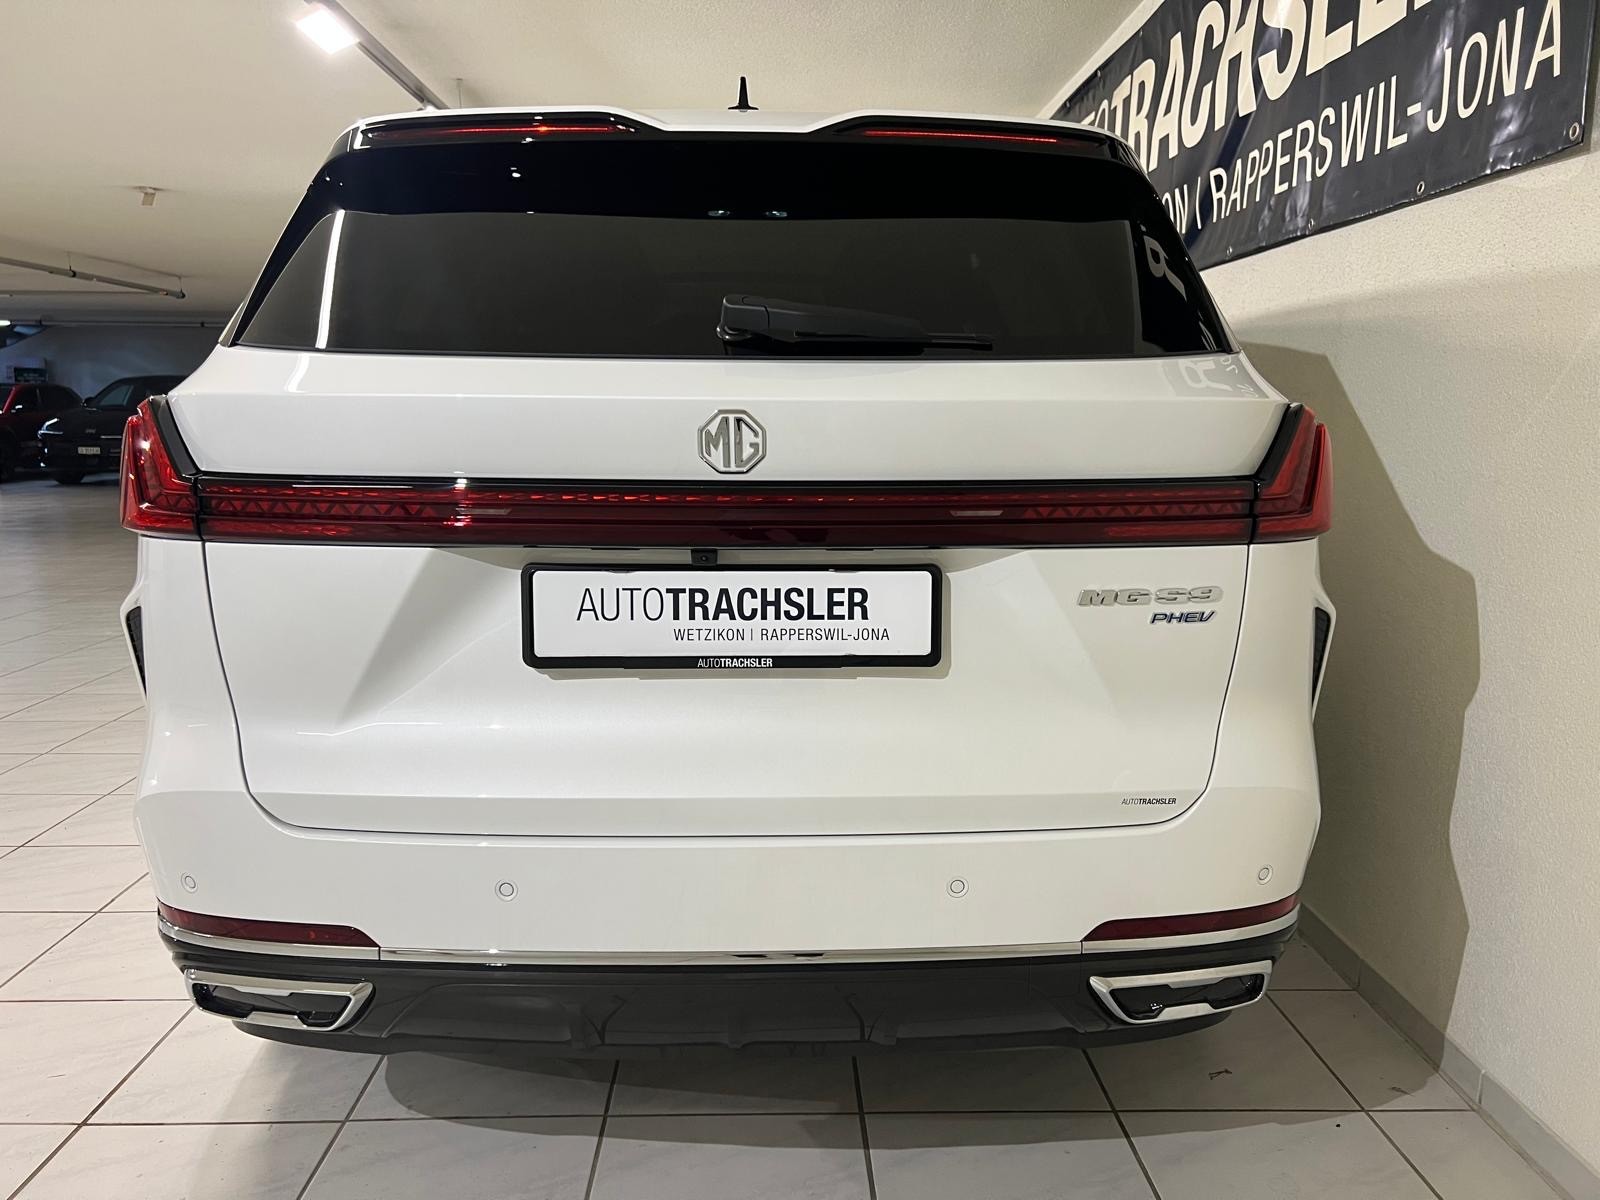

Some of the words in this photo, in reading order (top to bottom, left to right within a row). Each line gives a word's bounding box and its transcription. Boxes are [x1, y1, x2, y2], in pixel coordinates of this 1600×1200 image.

[1209, 0, 1561, 223] RAPPERSWIL-JONA
[704, 415, 761, 470] MG
[577, 587, 870, 622] AUTOTRACHSLER
[1150, 611, 1216, 625] PHEV
[673, 628, 745, 642] WETZIKON
[760, 627, 890, 642] RAPPERSWIL-JONA
[697, 657, 773, 669] AUTOTRACHSLER
[1121, 797, 1177, 806] AUTOTRACHSLER
